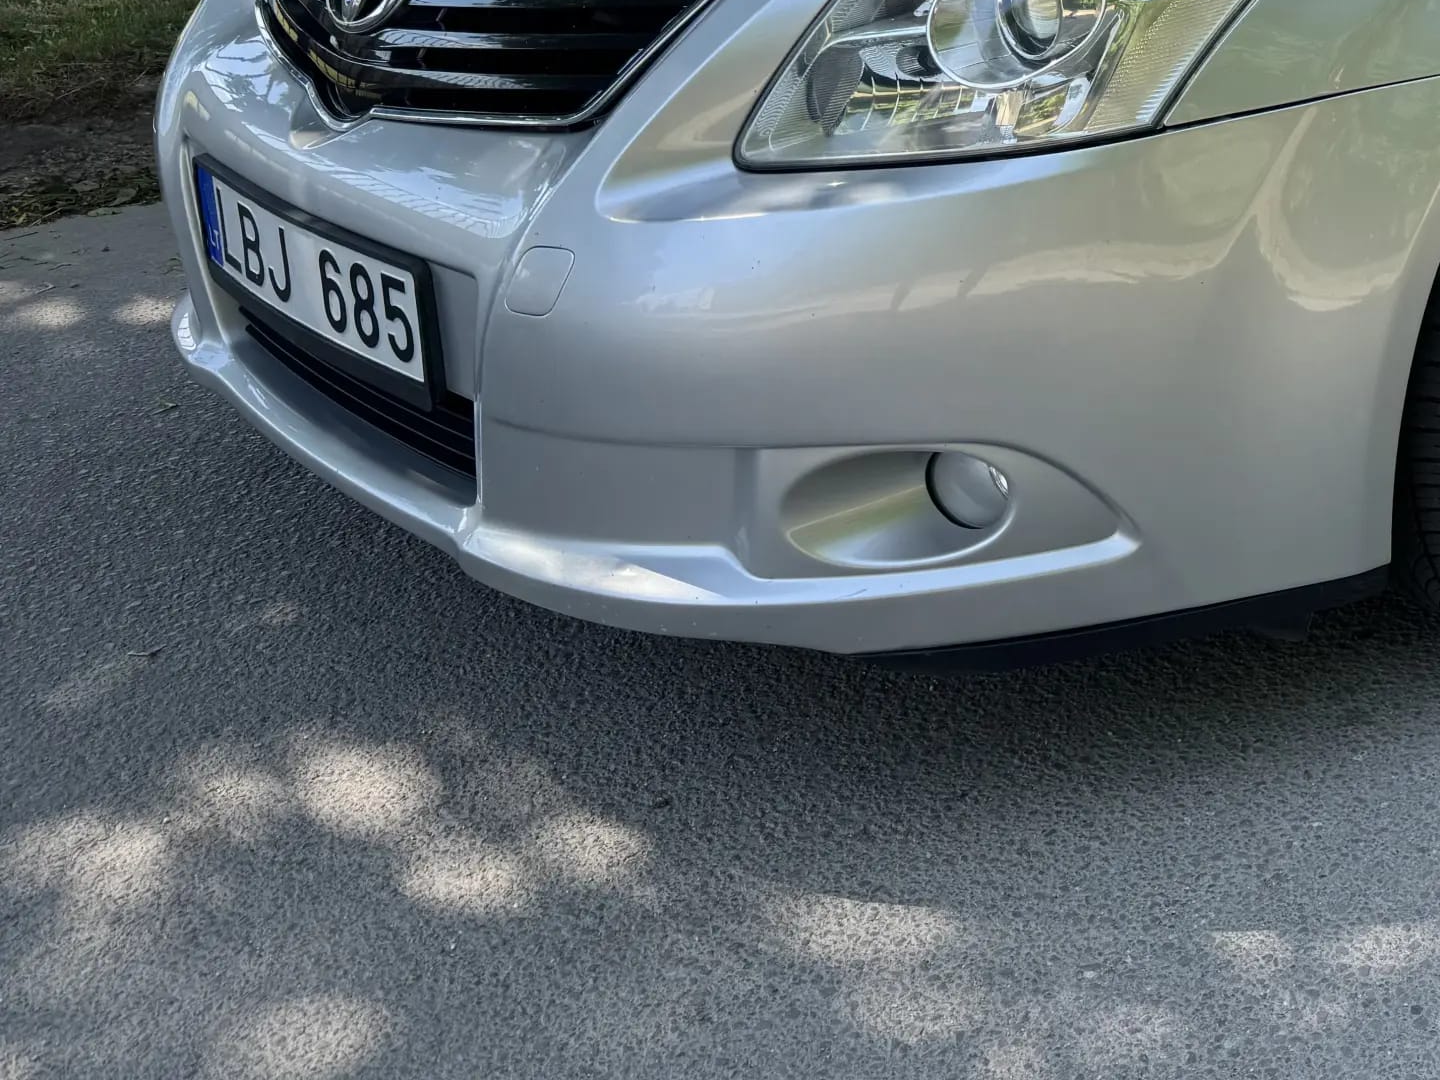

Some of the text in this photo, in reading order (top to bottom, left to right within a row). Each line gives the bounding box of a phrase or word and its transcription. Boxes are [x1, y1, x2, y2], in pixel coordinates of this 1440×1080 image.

[207, 224, 220, 249] LT
[216, 187, 415, 363] LBJ 685
